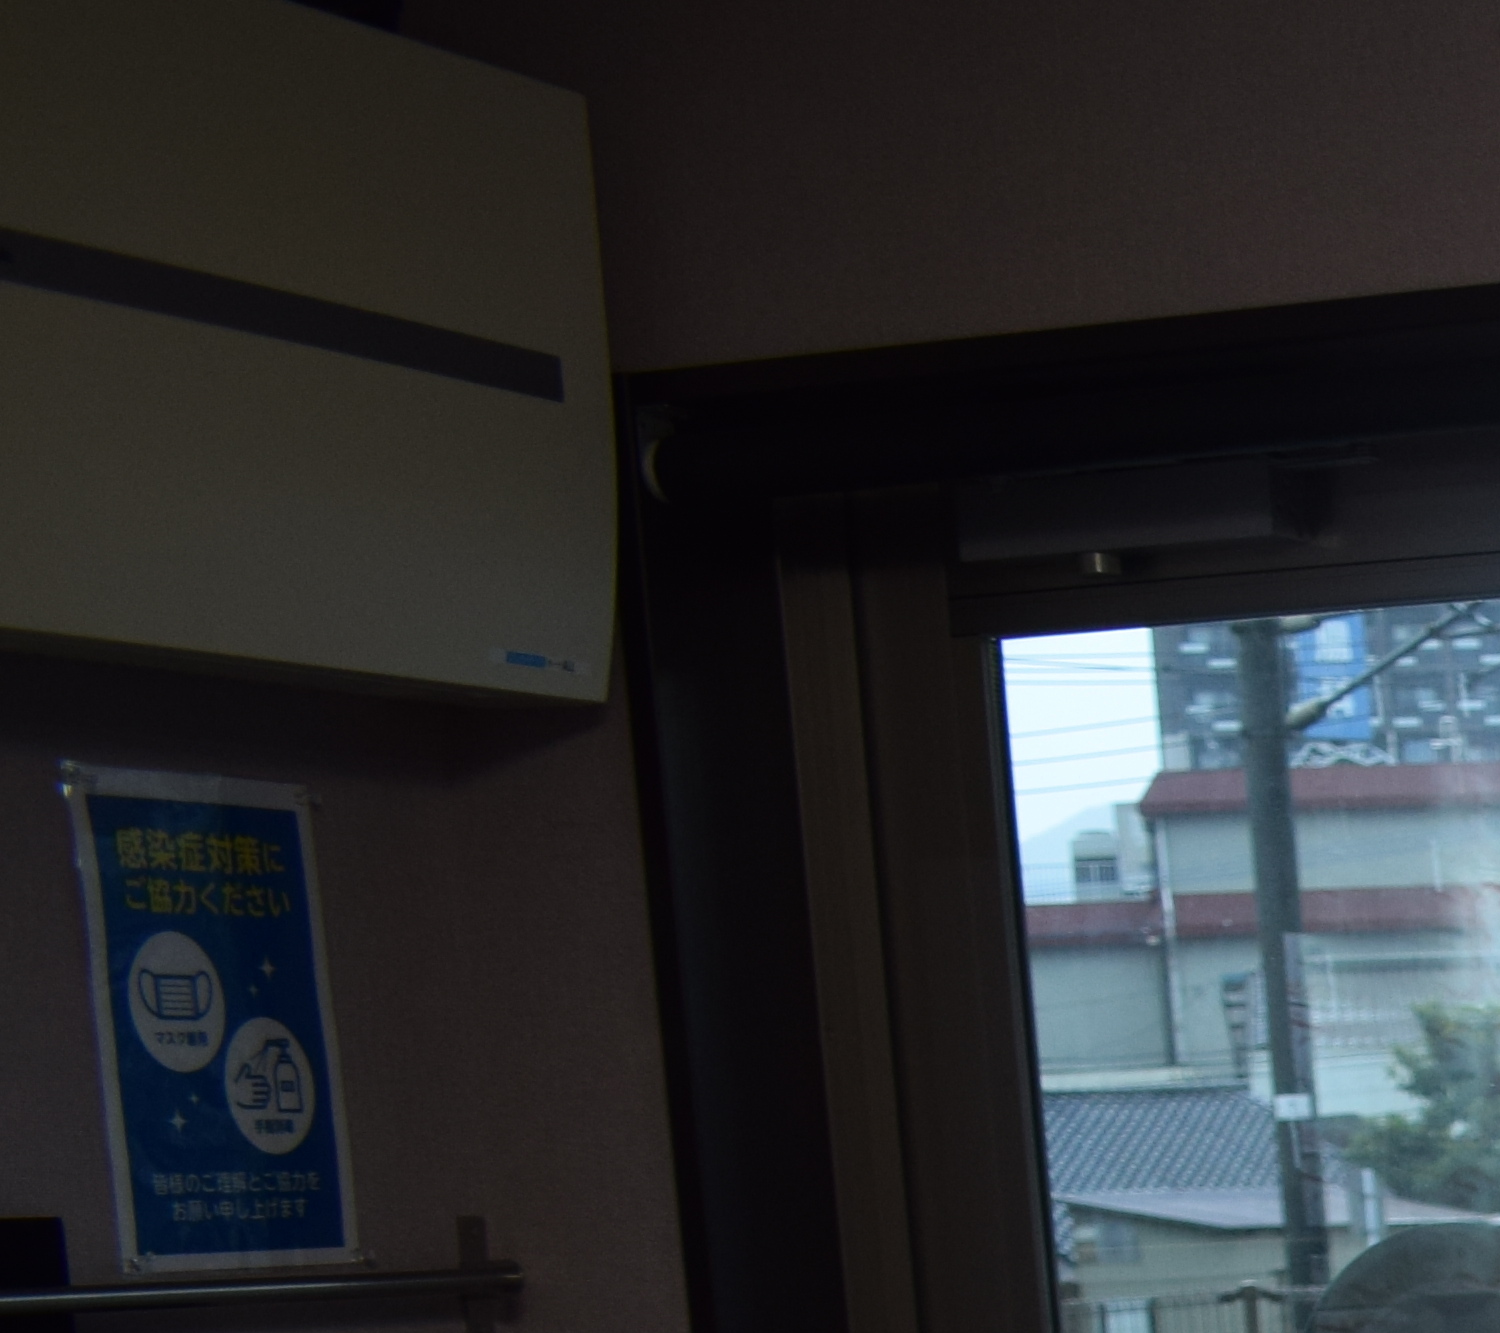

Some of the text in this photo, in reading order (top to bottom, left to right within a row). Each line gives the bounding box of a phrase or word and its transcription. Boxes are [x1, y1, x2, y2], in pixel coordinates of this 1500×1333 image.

[115, 826, 286, 875] 感染症対策に
[126, 876, 291, 918] ご協力ください
